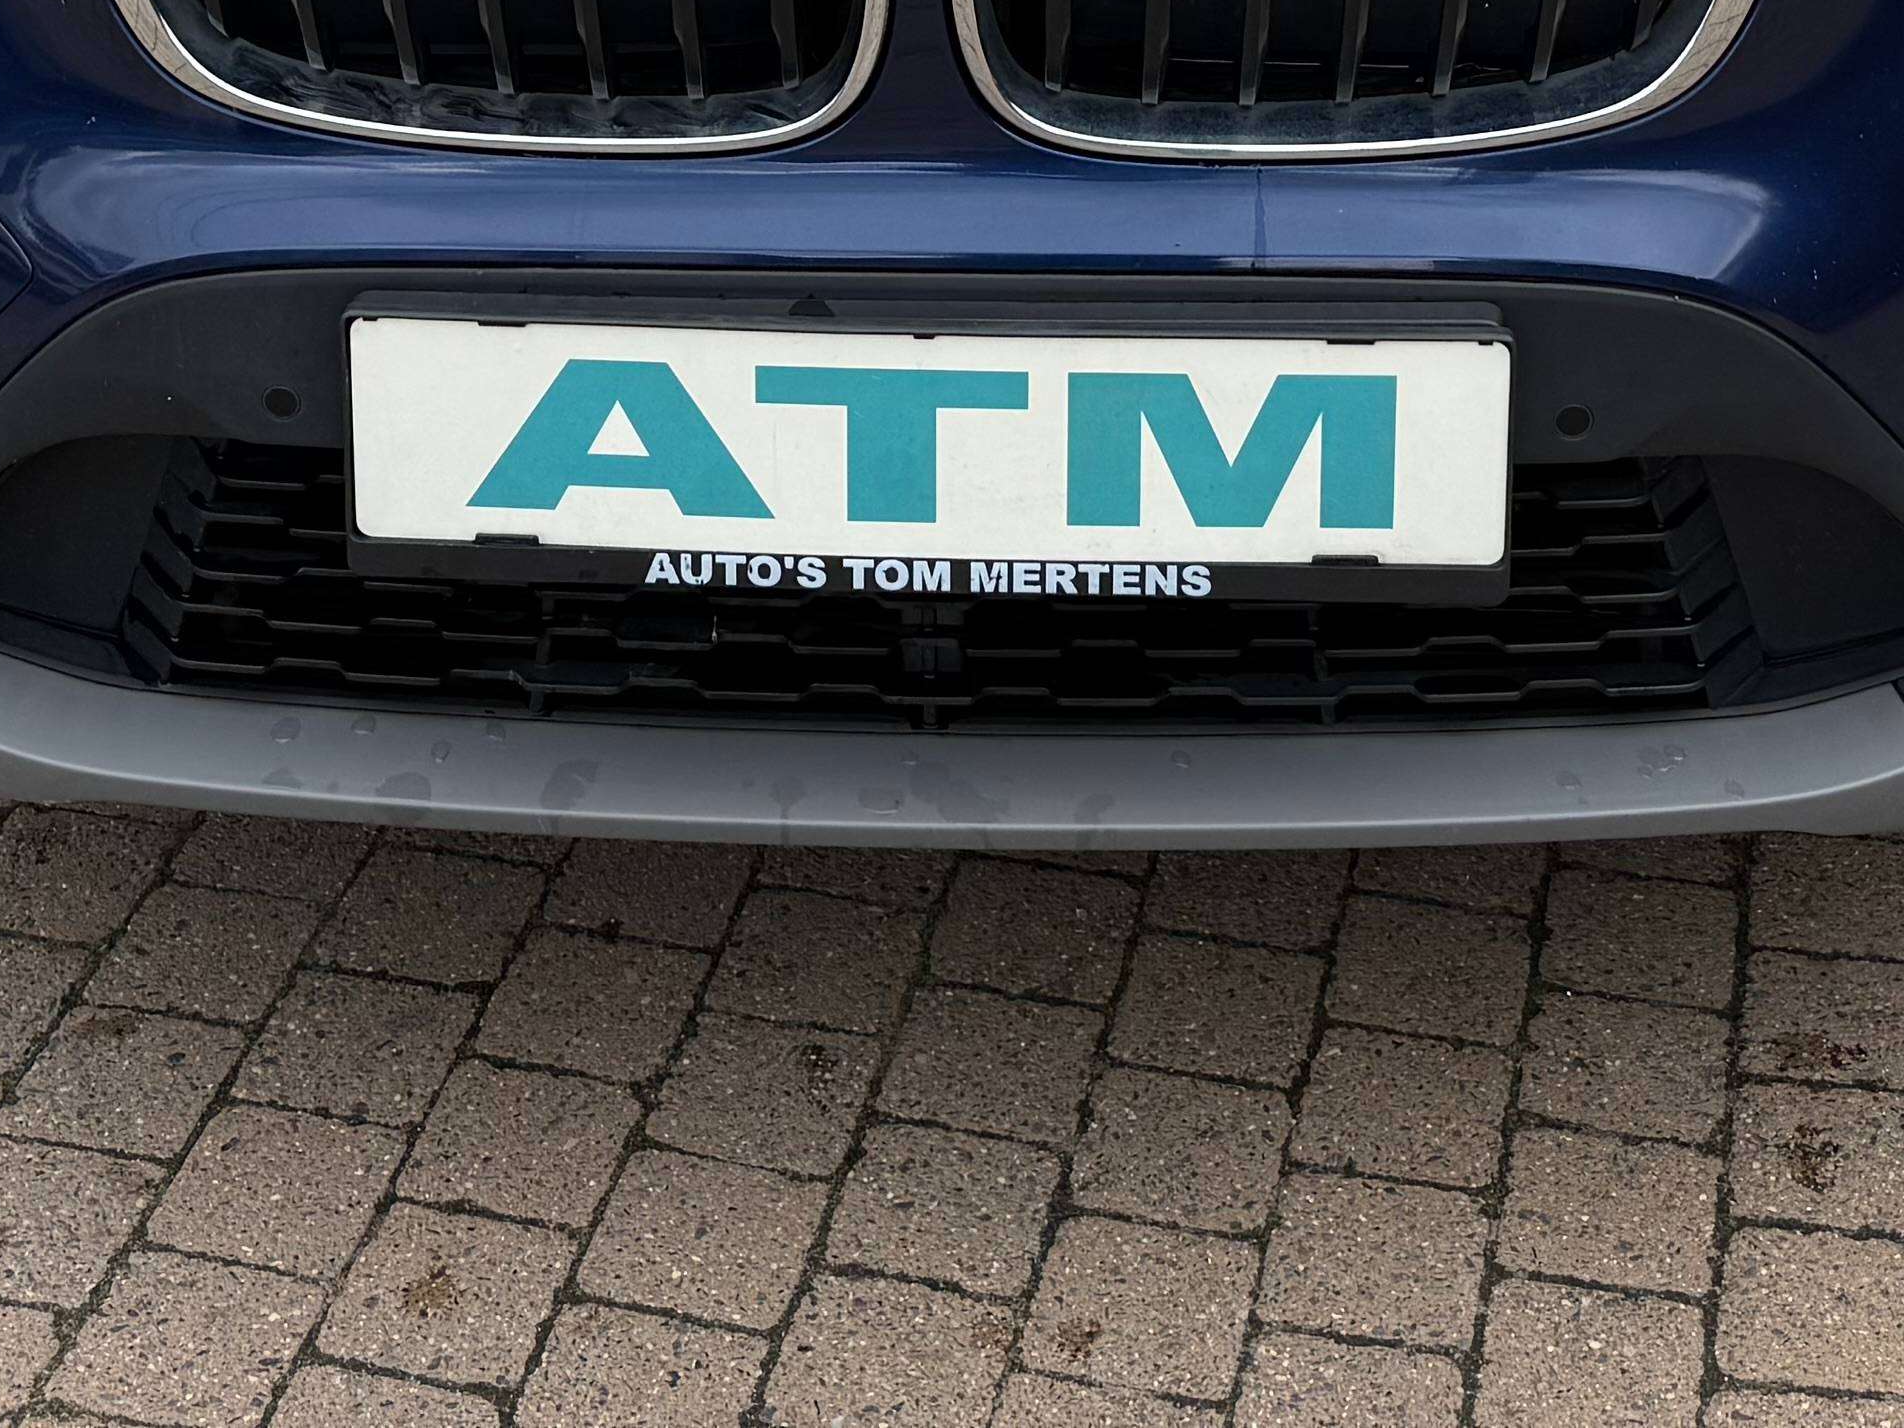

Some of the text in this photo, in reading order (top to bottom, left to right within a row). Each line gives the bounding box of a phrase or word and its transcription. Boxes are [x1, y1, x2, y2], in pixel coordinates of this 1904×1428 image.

[464, 357, 1399, 529] ATM
[645, 552, 1212, 596] AUTO'S TOM MERTENS
